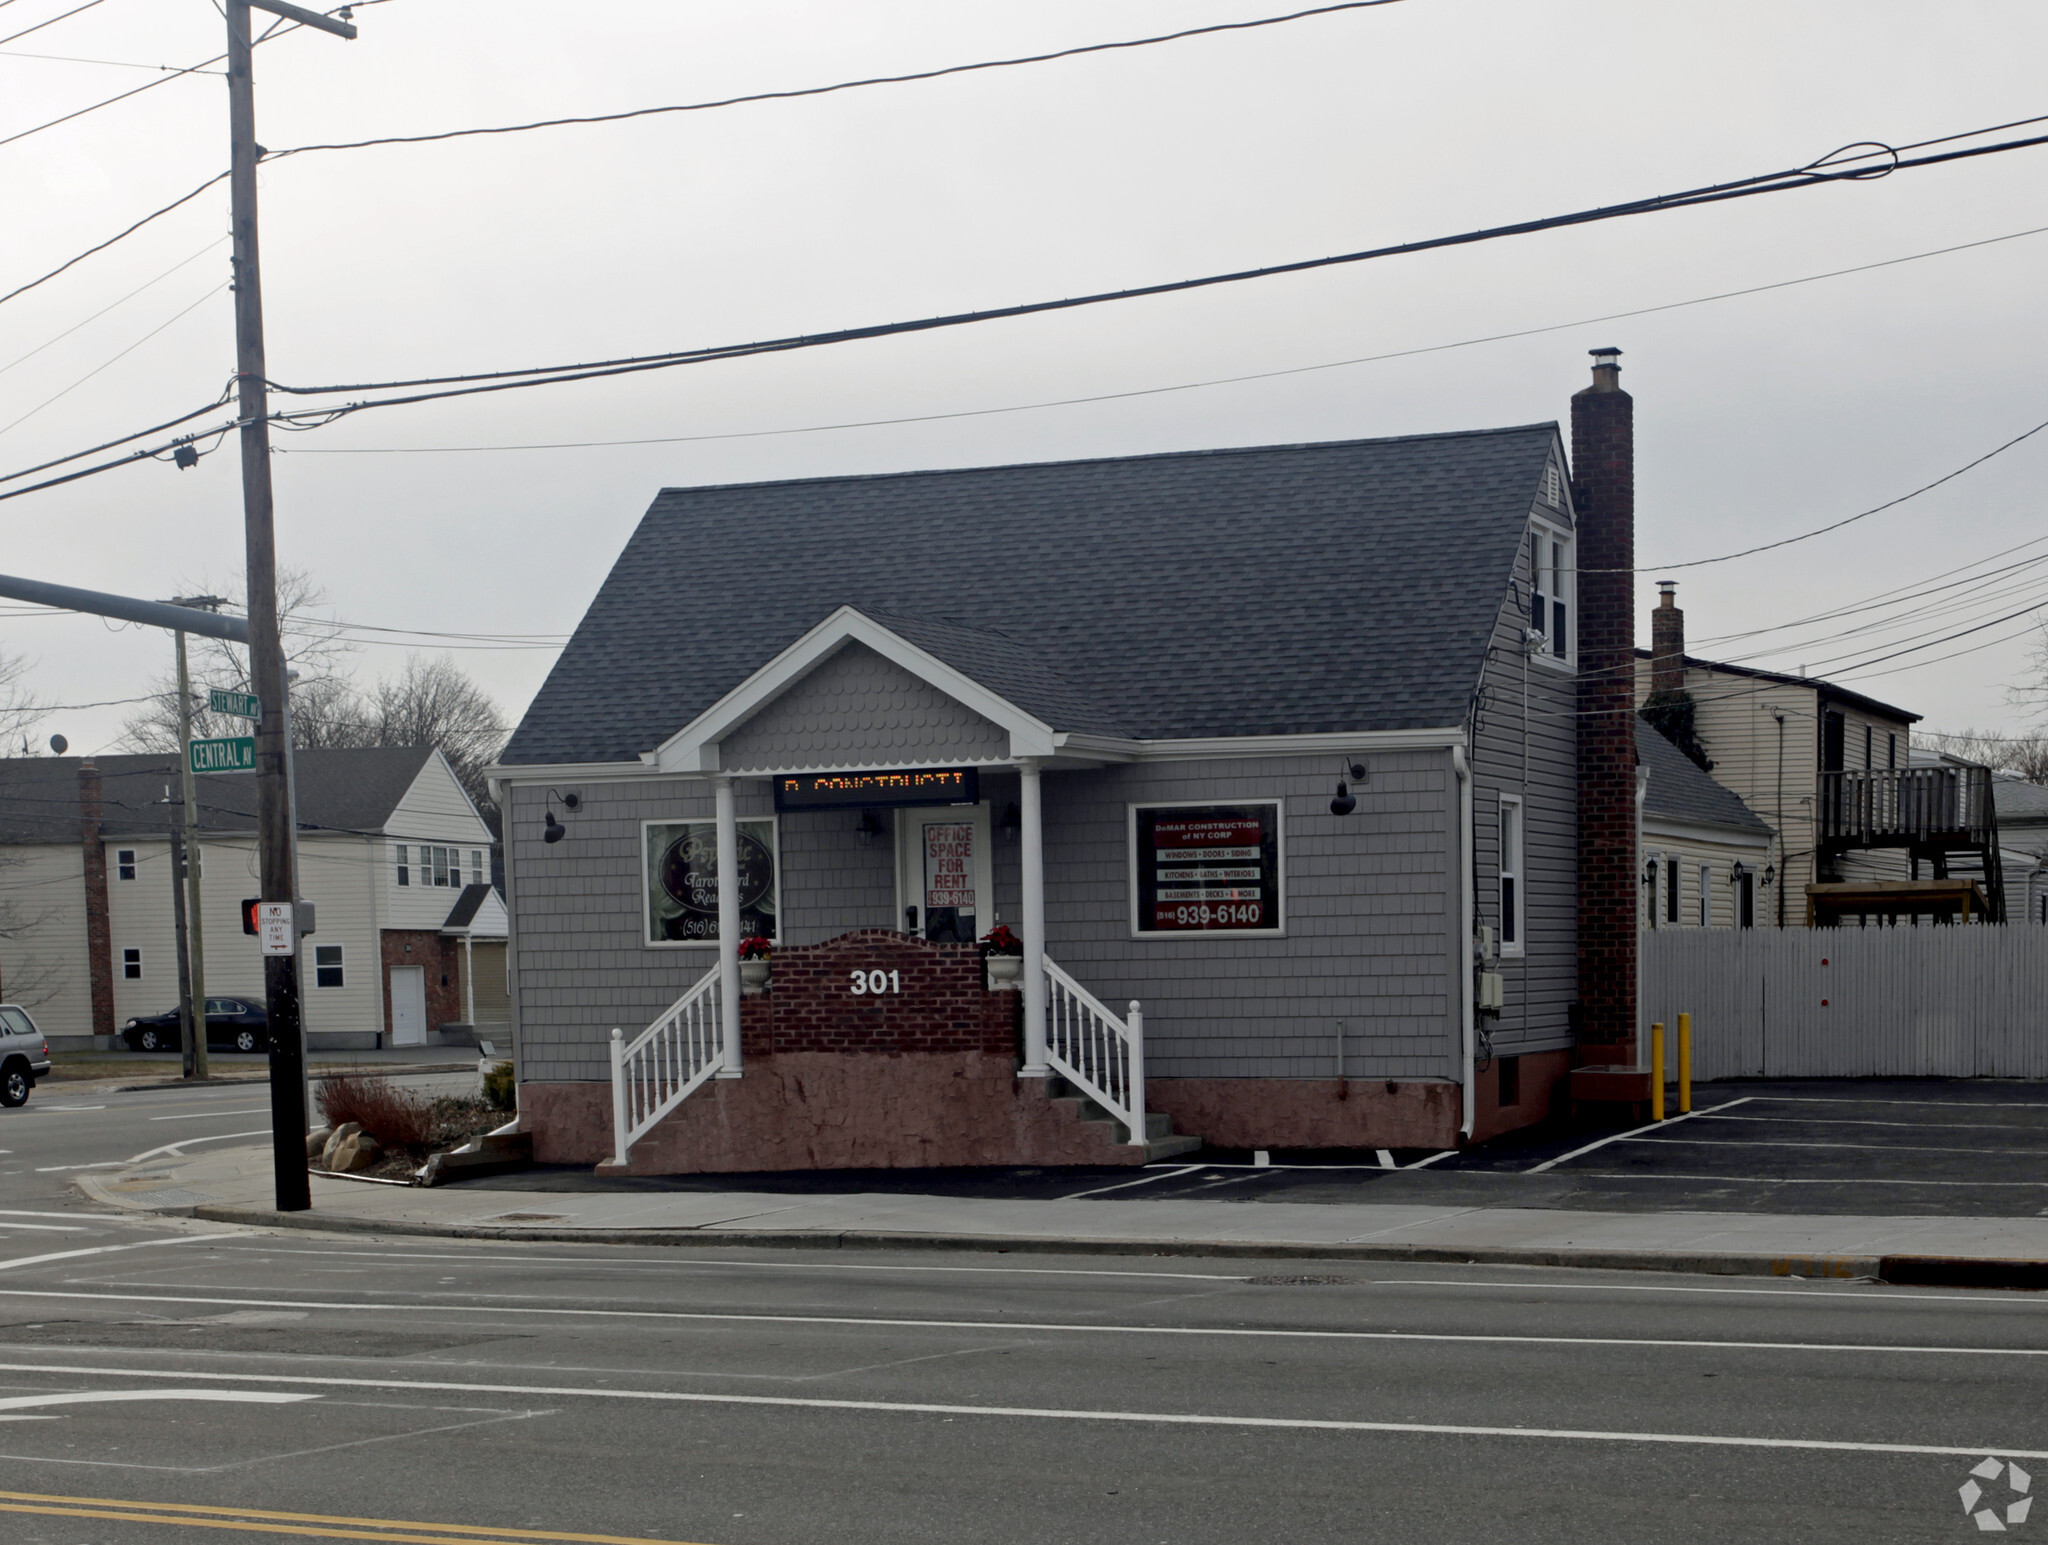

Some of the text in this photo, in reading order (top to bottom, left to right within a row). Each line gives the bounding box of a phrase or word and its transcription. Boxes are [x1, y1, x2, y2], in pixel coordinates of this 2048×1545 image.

[211, 691, 249, 715] STEWART
[193, 742, 252, 769] CENTRAL AV
[1188, 821, 1259, 831] CONSTRUCTION
[928, 827, 973, 842] OFFICE
[1193, 832, 1205, 840] NY
[1207, 831, 1232, 839] CORP
[679, 837, 753, 871] Psyic
[929, 843, 971, 858] SPACE
[1165, 849, 1252, 859] WINDOWS DOORS SIDING
[938, 858, 964, 873] FOR
[934, 874, 968, 889] RENT
[1164, 871, 1194, 879] KITCHENS
[1224, 869, 1255, 878] INTERIORS
[932, 891, 975, 905] 939-6140
[1165, 891, 1200, 899] BASEMENTS
[1205, 890, 1224, 898] DECKS
[1238, 889, 1256, 898] MORE
[269, 907, 282, 917] NO
[1156, 904, 1260, 925] (516) 939-6140
[262, 917, 290, 925] STOPPING
[682, 918, 708, 936] (516)
[850, 969, 900, 995] 301
